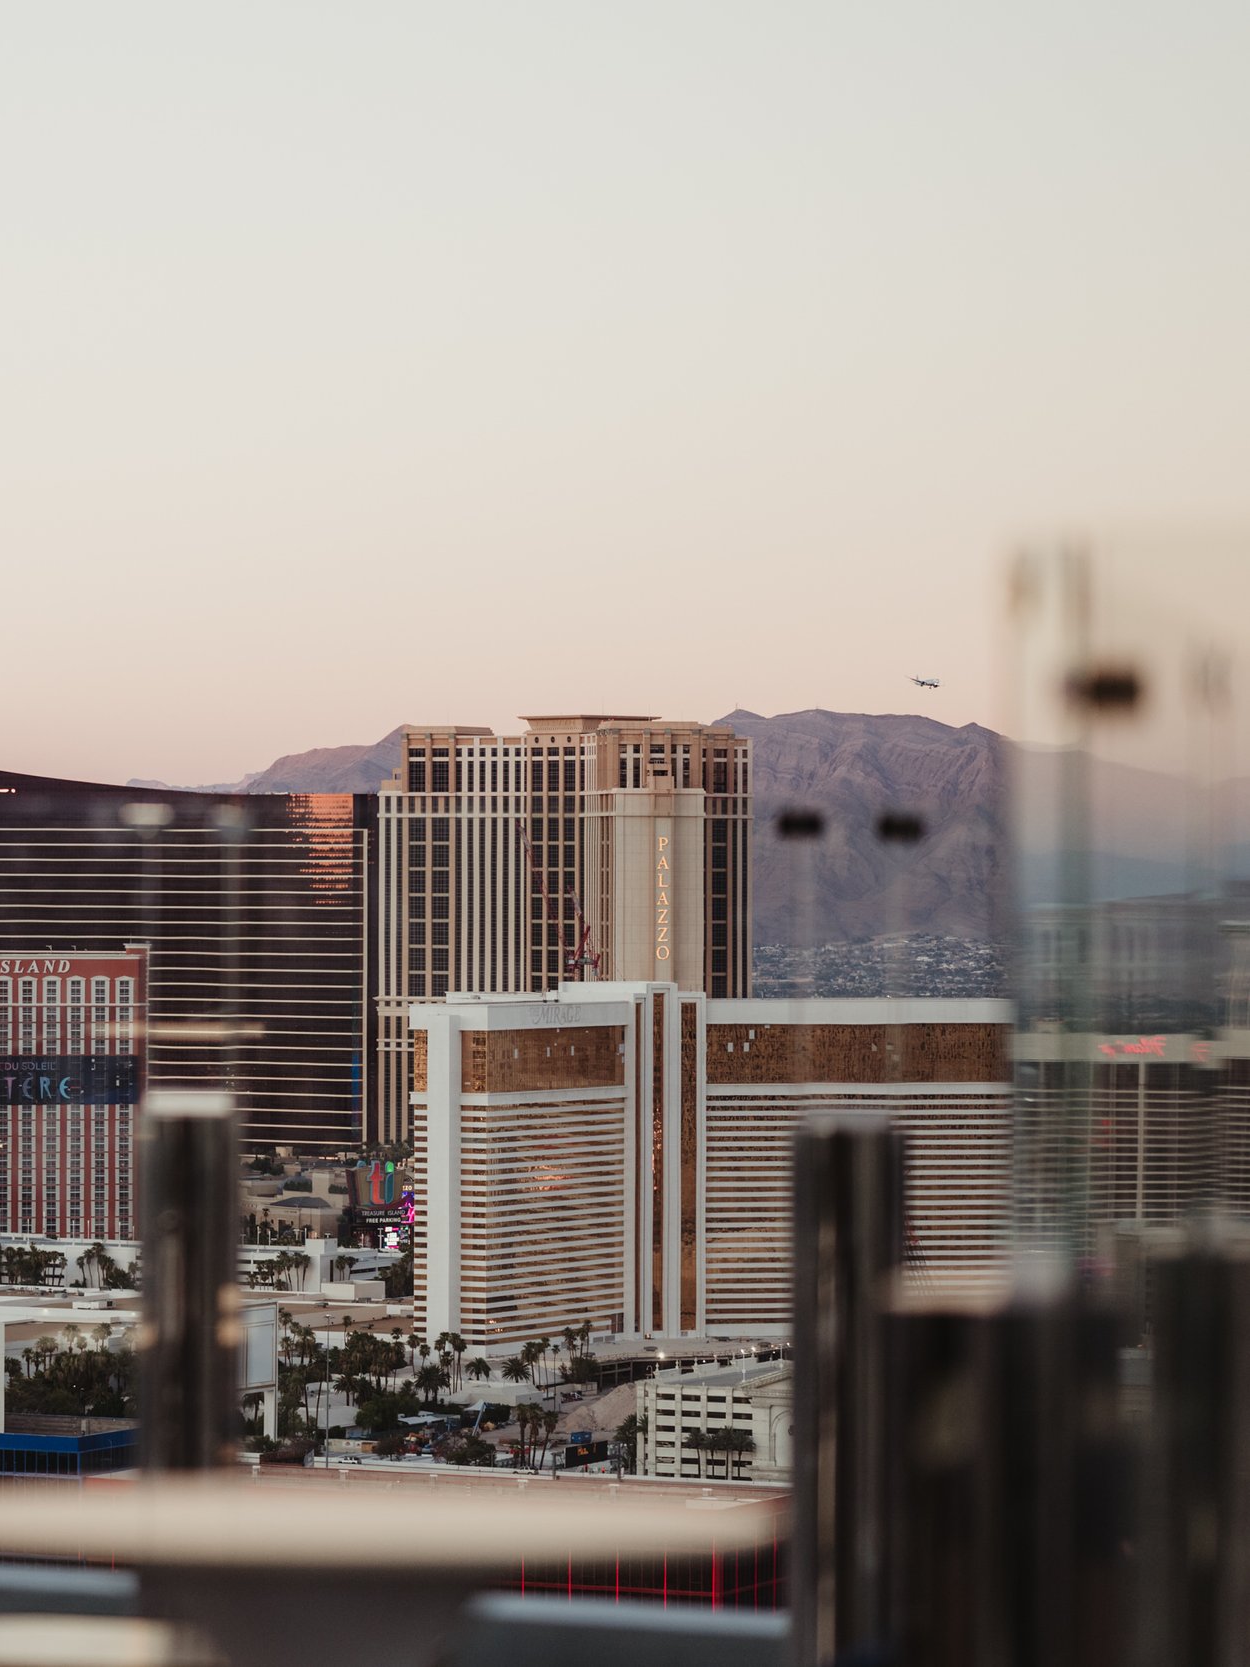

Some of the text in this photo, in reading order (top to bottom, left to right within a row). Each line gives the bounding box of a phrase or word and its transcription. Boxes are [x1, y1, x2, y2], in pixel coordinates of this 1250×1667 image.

[656, 836, 670, 960] PALAZZO
[533, 1004, 582, 1025] MIRAGE
[5, 1062, 19, 1071] DU
[22, 1062, 56, 1071] SOLEIL
